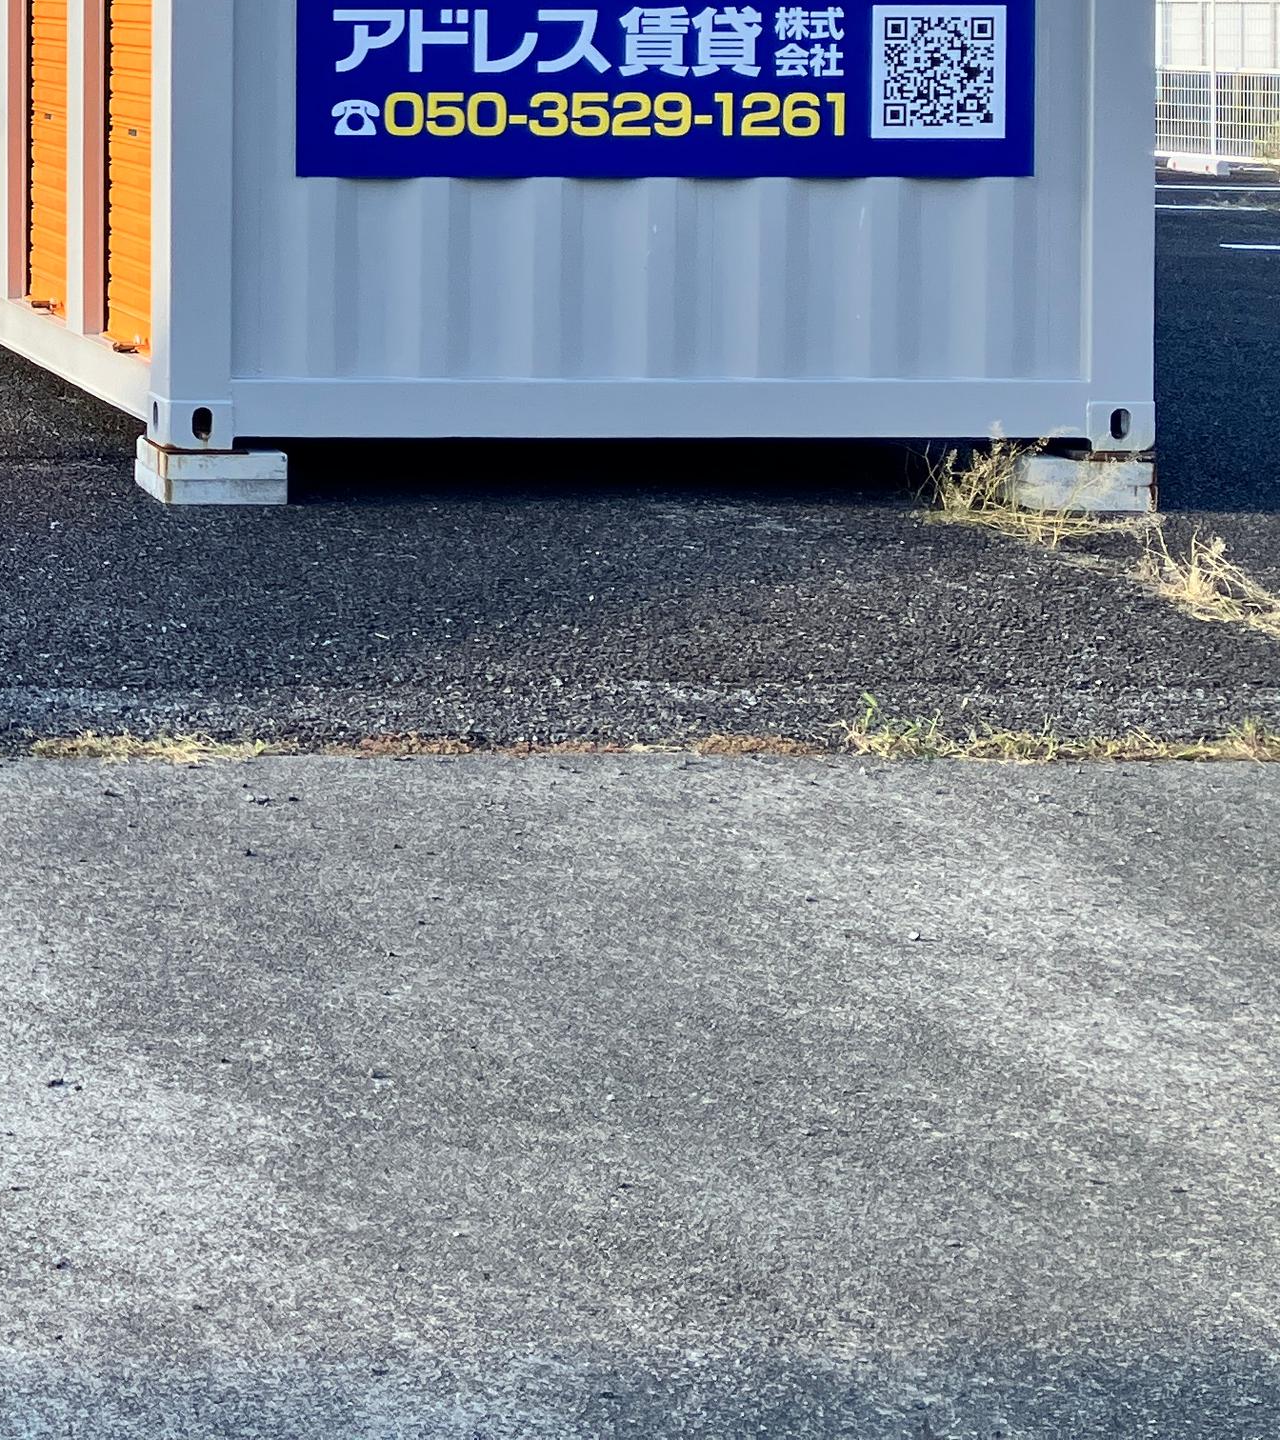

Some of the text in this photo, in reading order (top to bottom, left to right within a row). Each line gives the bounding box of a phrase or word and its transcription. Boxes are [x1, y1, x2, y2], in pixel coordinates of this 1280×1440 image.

[333, 6, 763, 78] アドレス賃貸
[775, 6, 845, 41] 株式
[775, 43, 844, 77] 会社
[384, 92, 845, 137] 050-3529-1261
